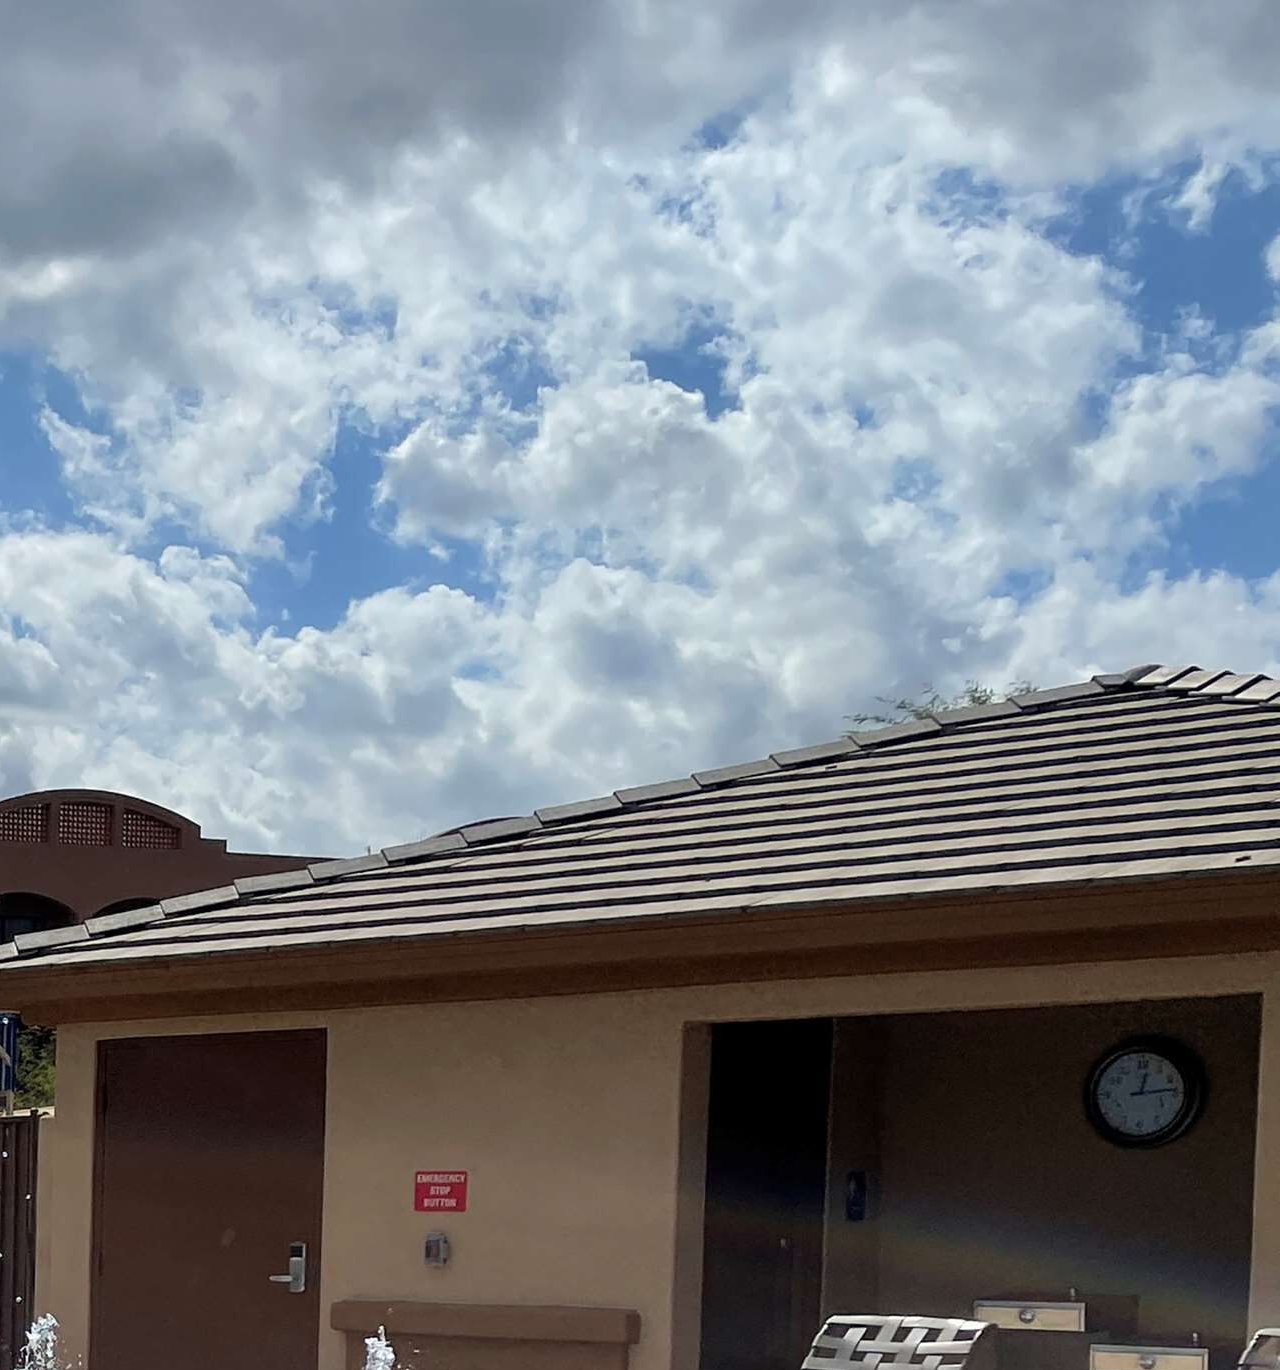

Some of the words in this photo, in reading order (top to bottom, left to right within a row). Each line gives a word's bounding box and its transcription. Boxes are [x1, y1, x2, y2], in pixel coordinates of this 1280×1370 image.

[417, 1174, 465, 1183] EMERGENCY
[430, 1186, 451, 1195] STOP
[424, 1198, 457, 1207] BUTTON
